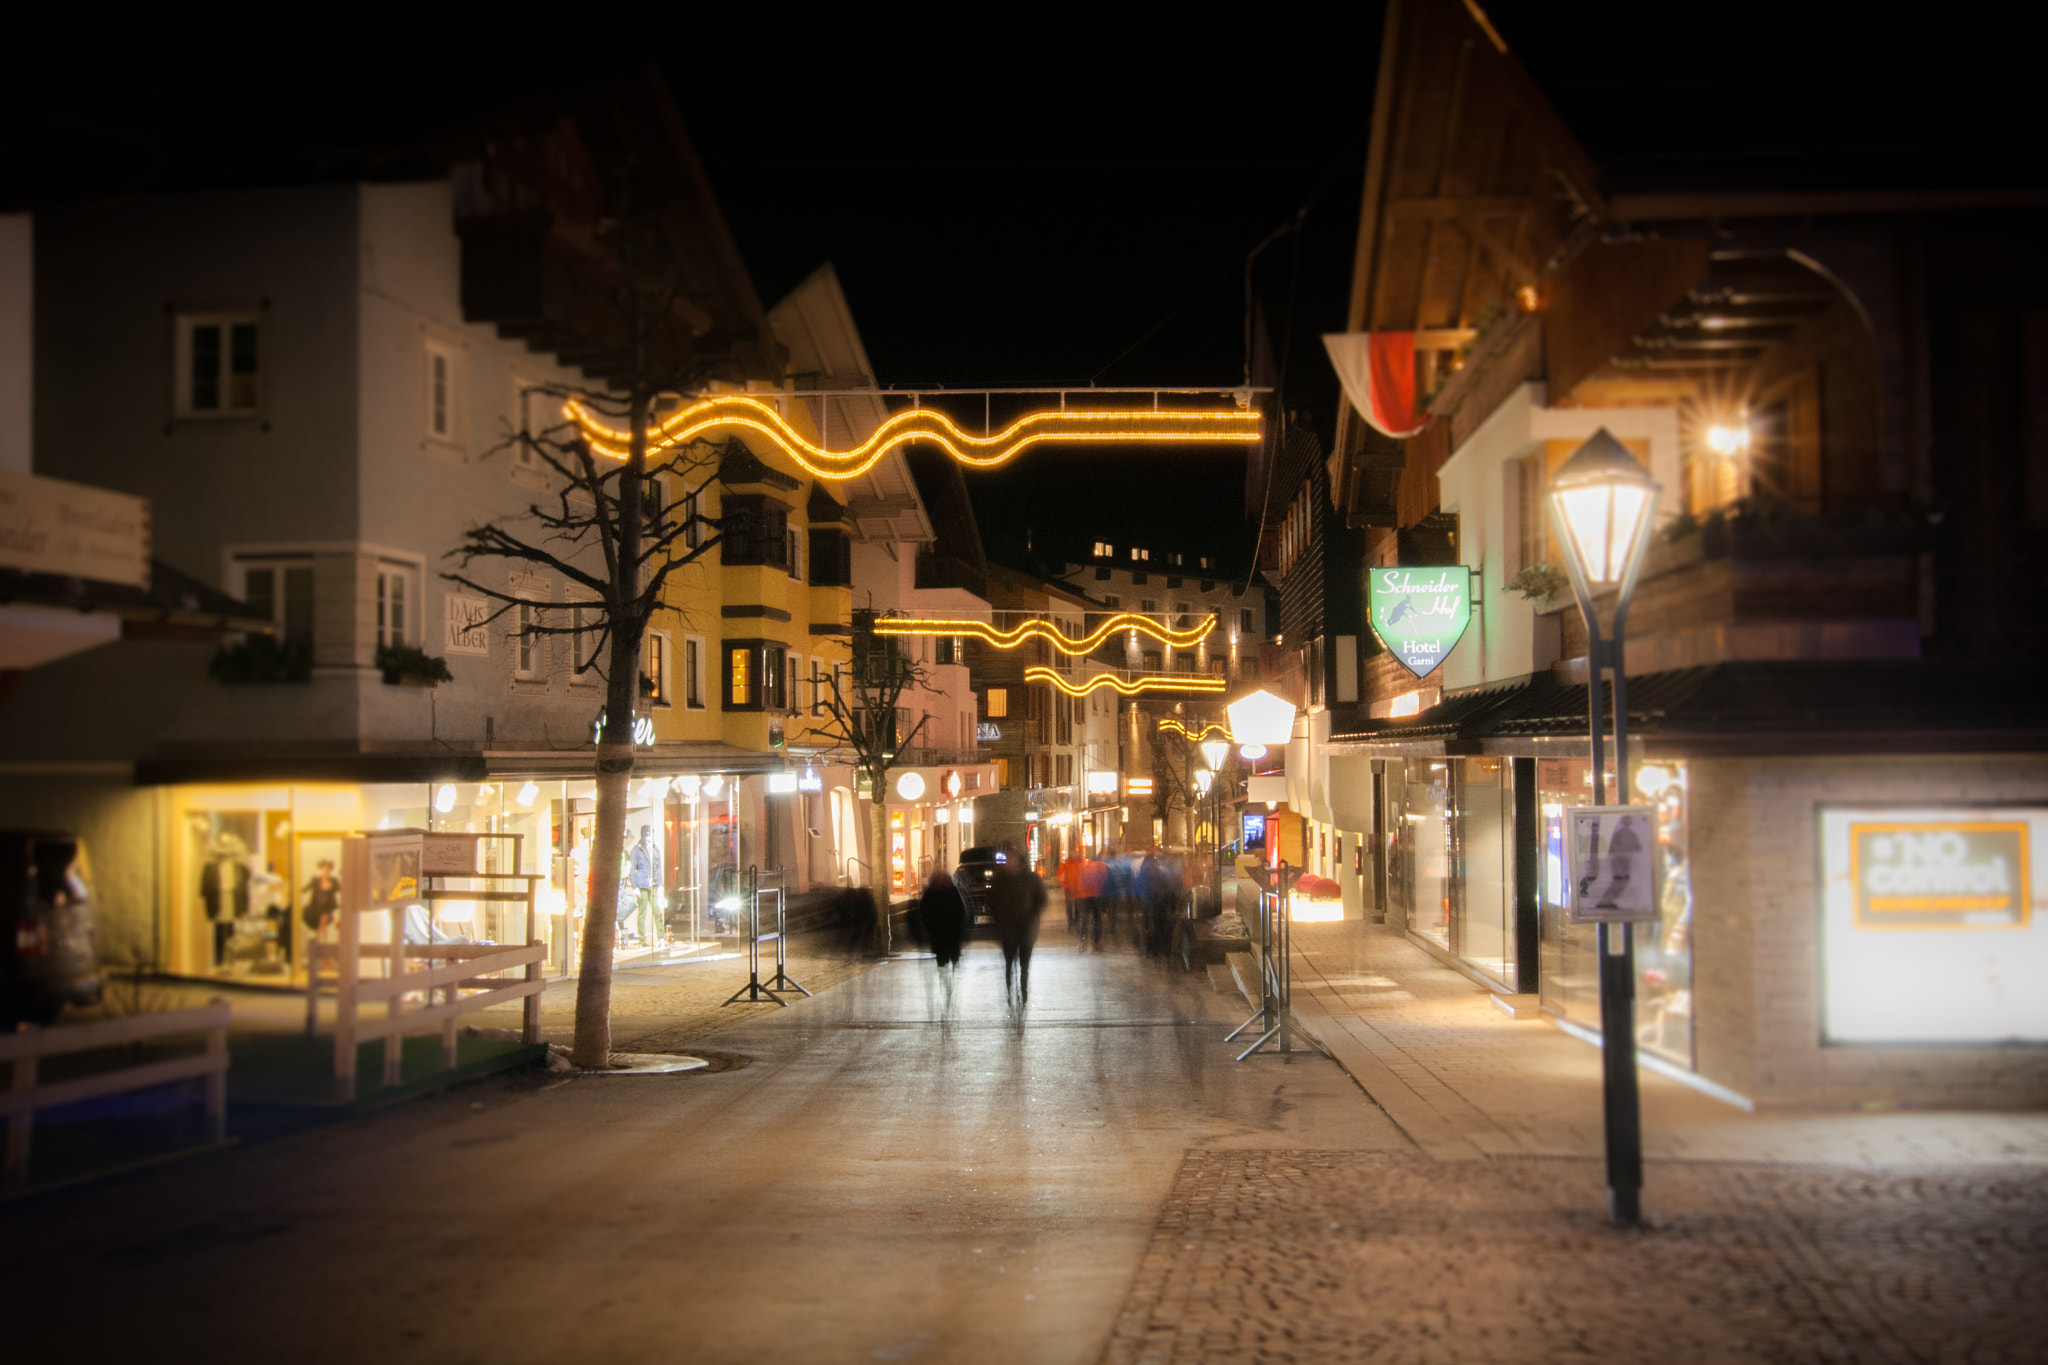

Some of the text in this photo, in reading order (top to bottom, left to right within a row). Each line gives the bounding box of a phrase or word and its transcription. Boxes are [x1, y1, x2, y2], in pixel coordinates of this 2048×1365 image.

[1376, 570, 1459, 593] Schneider
[1422, 594, 1462, 621] Hof
[1403, 638, 1441, 653] Hotel
[1408, 656, 1434, 666] Garni
